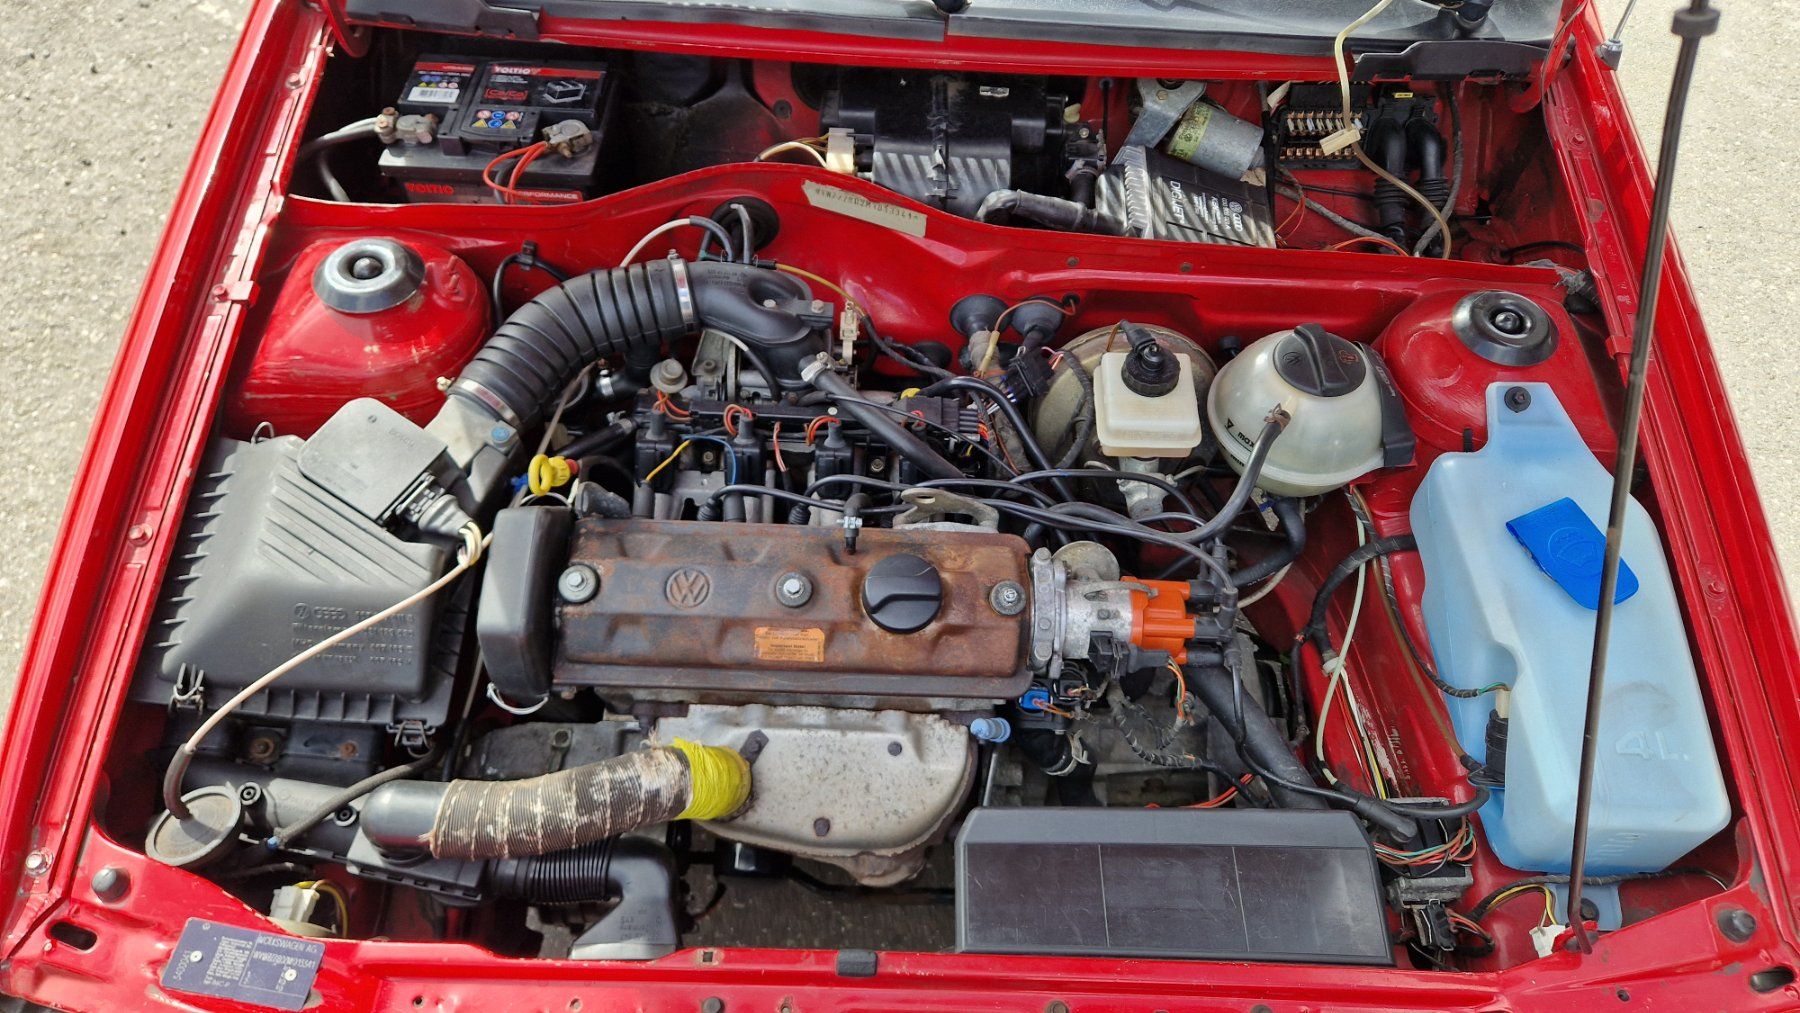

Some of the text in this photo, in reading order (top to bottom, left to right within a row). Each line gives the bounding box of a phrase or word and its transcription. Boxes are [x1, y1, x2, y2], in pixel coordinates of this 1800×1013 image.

[495, 66, 531, 75] VOLTIO
[1237, 431, 1255, 448] max
[257, 935, 318, 954] VOLKSWAGEN AG
